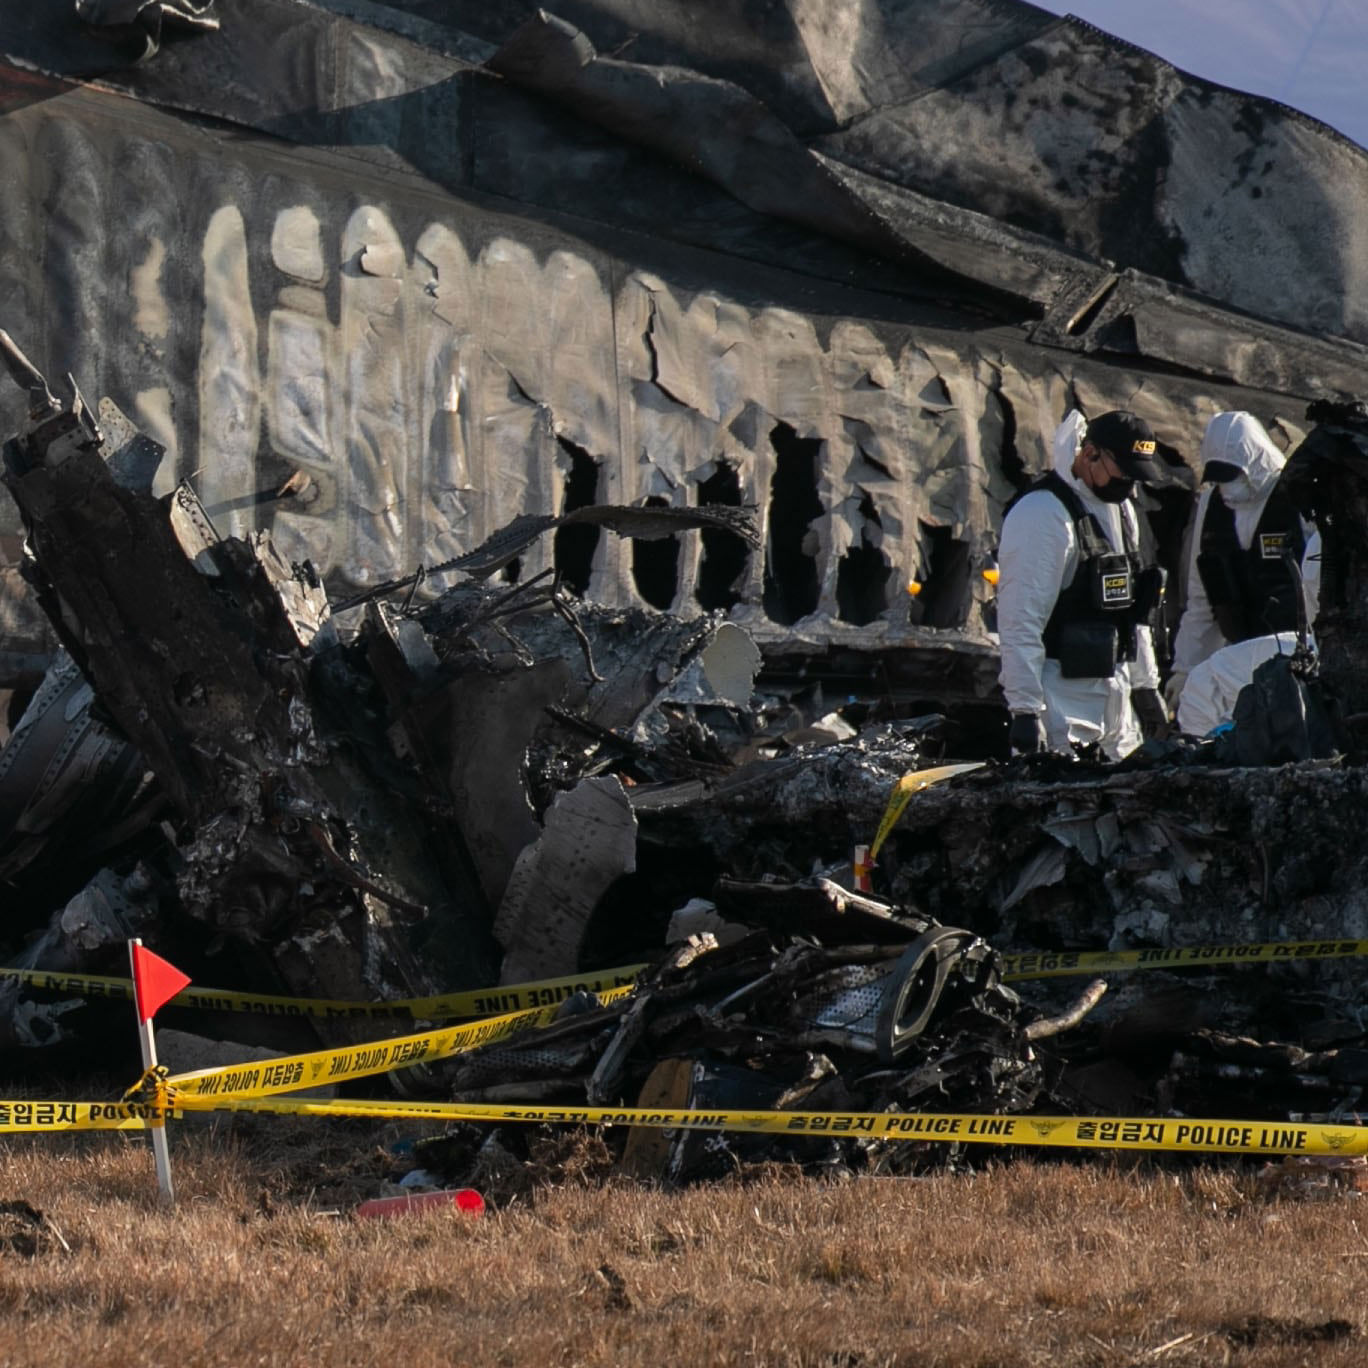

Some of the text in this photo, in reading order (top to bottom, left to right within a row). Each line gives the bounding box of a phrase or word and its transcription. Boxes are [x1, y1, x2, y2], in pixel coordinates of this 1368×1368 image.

[885, 1118, 961, 1134] POLICE
[969, 1119, 1016, 1136] LINE
[1076, 1121, 1307, 1149] 출입금지 POLICE LINE
